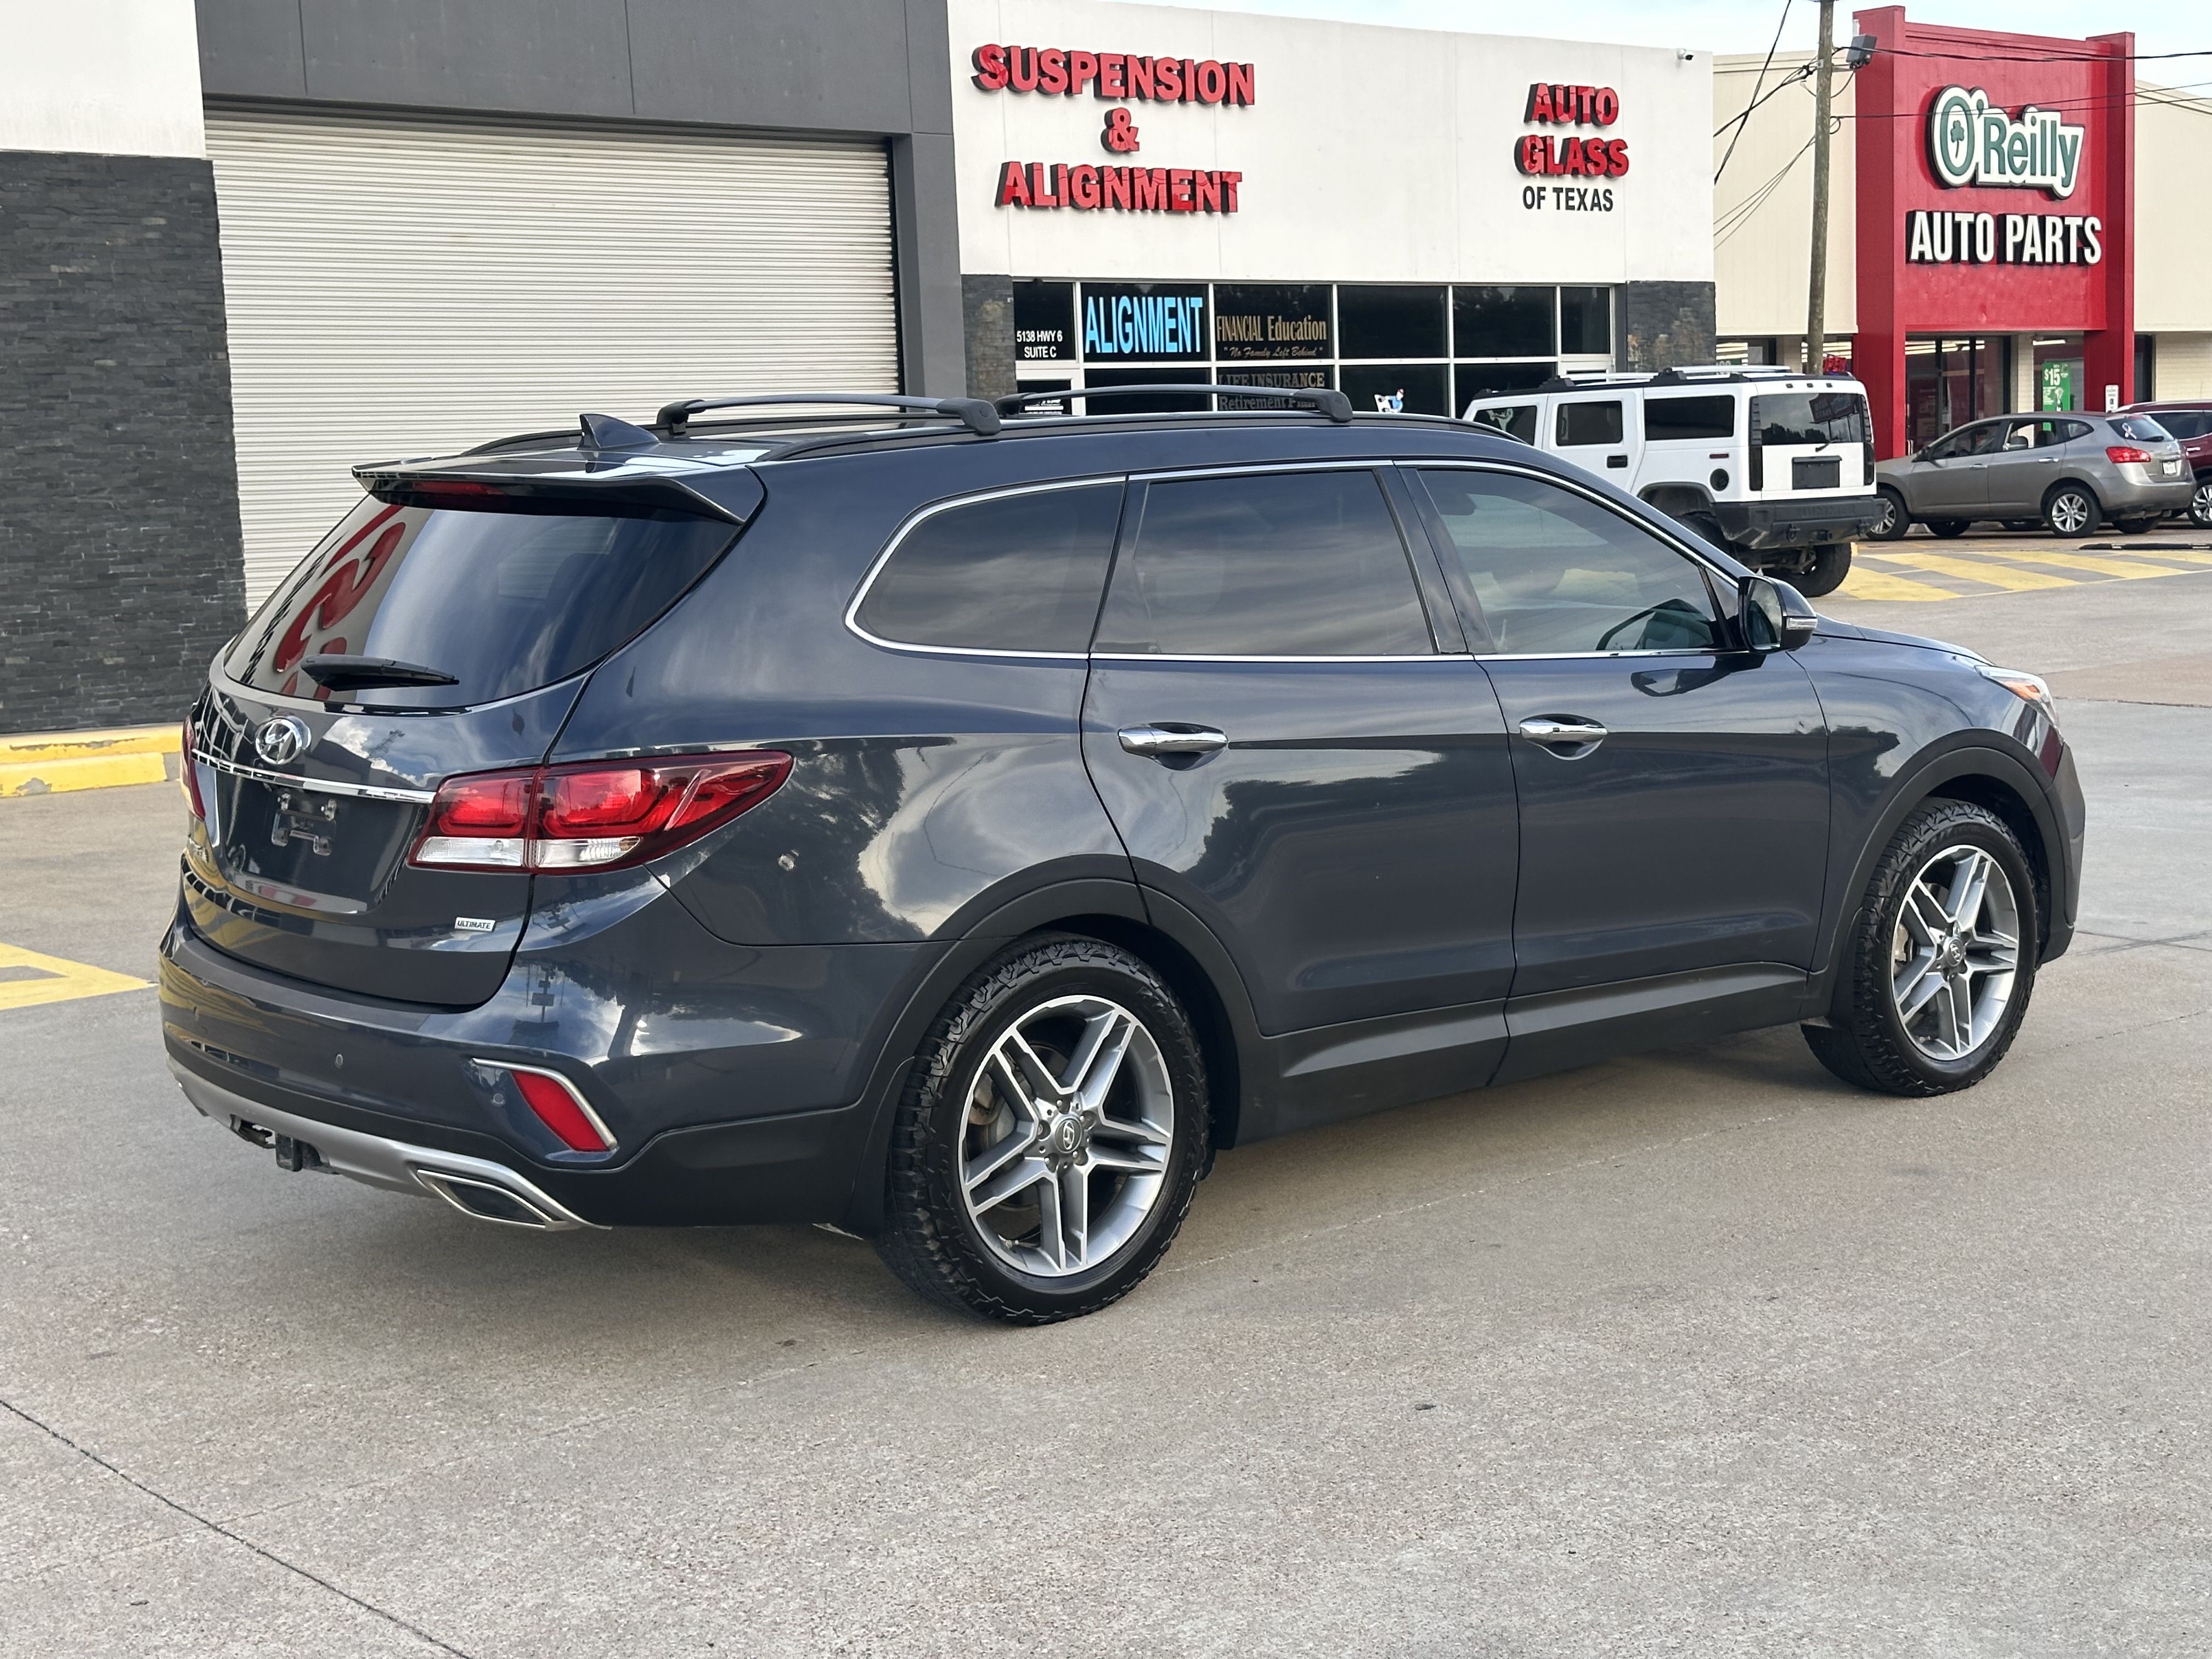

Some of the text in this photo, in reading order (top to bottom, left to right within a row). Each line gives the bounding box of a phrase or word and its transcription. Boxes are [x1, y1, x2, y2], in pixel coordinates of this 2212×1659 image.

[972, 44, 1255, 106] SUSPENSION
[1523, 83, 1619, 125] AUTO
[1101, 107, 1140, 153] &
[1939, 95, 2080, 188] O'Reilly
[1514, 134, 1629, 177] GLASS
[994, 161, 1243, 213] ALIGNMENT
[1522, 185, 1614, 212] OF TEXAS
[1908, 210, 2102, 264] AUTO PARTS
[1016, 330, 1063, 343] 5138 HWY 6
[1085, 295, 1203, 354] ALIGNMENT
[1216, 314, 1327, 342] FINANCIAL Education
[1024, 346, 1057, 358] SUITE C
[1243, 347, 1271, 359] Family
[1250, 372, 1325, 387] INSURANCE
[2044, 368, 2061, 386] $15
[1218, 395, 1286, 411] Retirement
[457, 920, 491, 929] ULTIMATE
